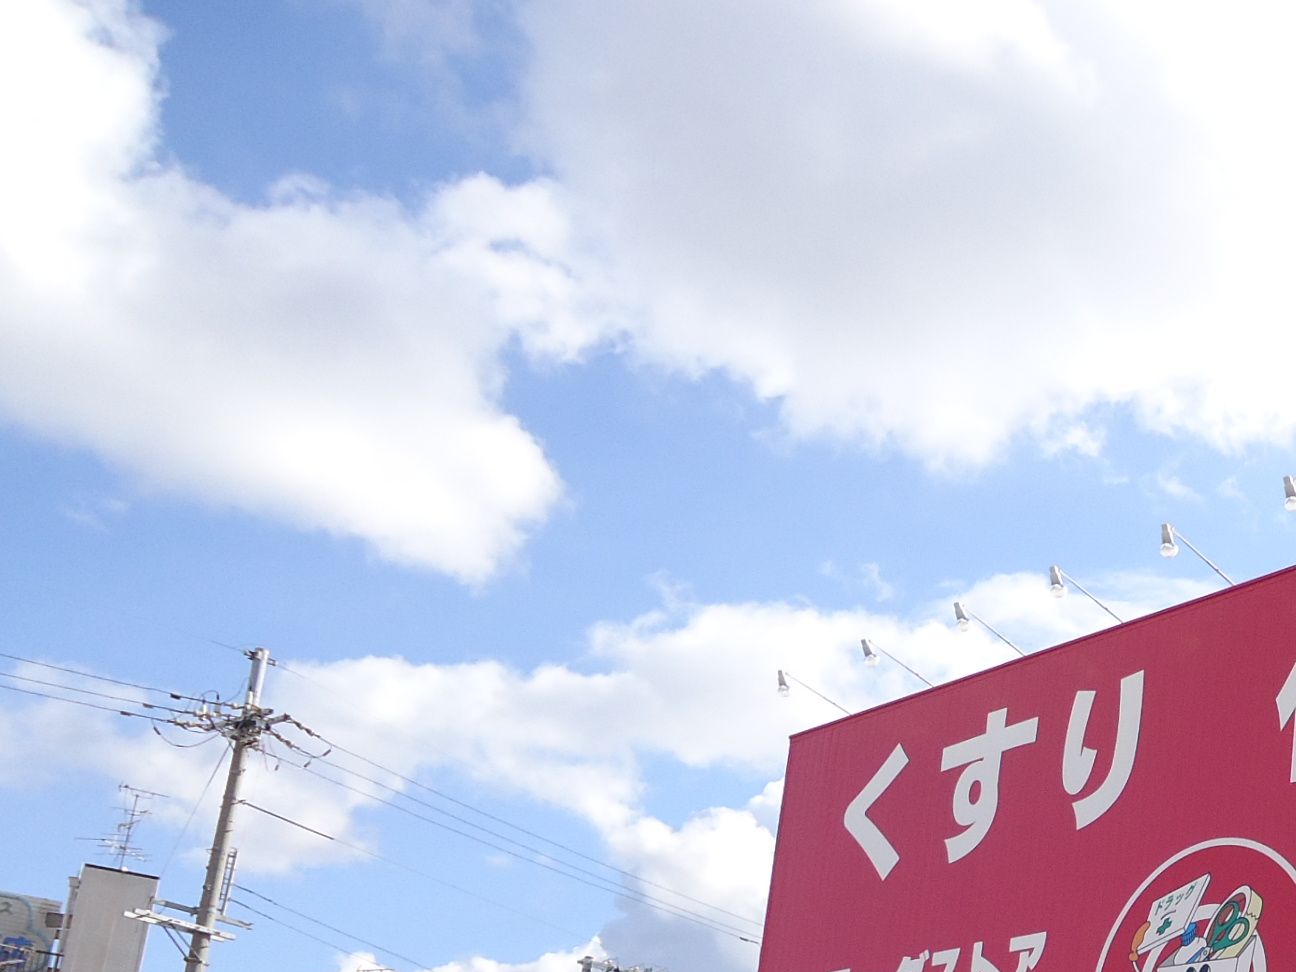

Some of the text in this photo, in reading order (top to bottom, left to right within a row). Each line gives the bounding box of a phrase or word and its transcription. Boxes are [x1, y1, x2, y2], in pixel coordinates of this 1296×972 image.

[844, 671, 1145, 881] くすり
[1155, 882, 1198, 915] ドラッグ
